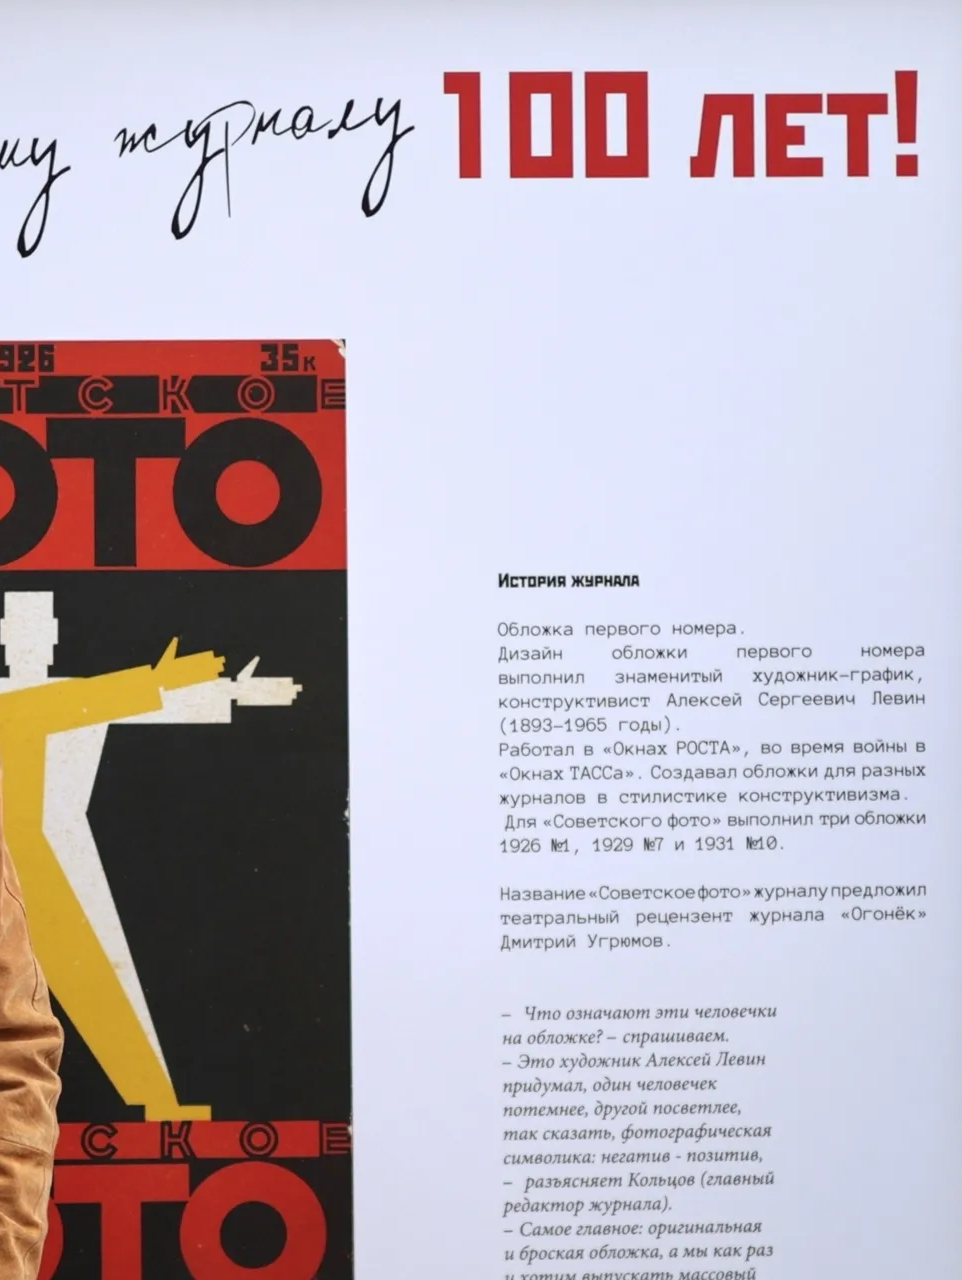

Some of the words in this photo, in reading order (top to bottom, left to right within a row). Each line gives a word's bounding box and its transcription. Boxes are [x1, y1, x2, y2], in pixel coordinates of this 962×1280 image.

[114, 97, 415, 240] журналу
[443, 71, 650, 179] 100
[496, 622, 574, 638] Обложка
[584, 624, 662, 640] первого
[671, 624, 745, 639] номера.
[497, 646, 563, 664] Дизайн
[611, 645, 688, 661] обложки
[736, 647, 813, 662] первого
[860, 645, 926, 661] номера
[497, 673, 585, 686] выполнил
[614, 669, 723, 685] знаменитый
[498, 696, 651, 713] конструктивист
[665, 693, 743, 708] Алексей
[757, 692, 856, 710] Сергеевич
[871, 690, 926, 706] Левин
[618, 715, 680, 735] годы).
[498, 742, 575, 758] Работал
[583, 745, 595, 757] в
[602, 741, 668, 757] «Окнах
[676, 740, 749, 759] РОСТА»,
[760, 743, 783, 755] во
[790, 742, 845, 758] время
[852, 739, 908, 754] войны
[915, 742, 927, 753] в
[499, 766, 565, 782] «Окнах
[569, 765, 642, 781] ТАССа».
[650, 764, 738, 783] Создавал
[742, 764, 819, 779] обложки
[823, 766, 856, 781] для
[861, 766, 927, 781] разных
[499, 793, 587, 809] журналов
[597, 793, 608, 805] в
[618, 792, 728, 805] стилистике
[738, 790, 908, 806] конструктивизма.
[503, 814, 537, 833] Для
[542, 814, 663, 829] «Советского
[666, 813, 722, 831] фото»
[727, 815, 814, 827] выполнил
[818, 814, 851, 830] три
[853, 810, 927, 826] обложки
[499, 838, 542, 854] 1926
[591, 837, 634, 853] 1929
[642, 837, 665, 852] №7
[674, 840, 685, 852] и
[694, 836, 735, 852] 1931
[499, 886, 587, 902] Название
[753, 886, 829, 903] журналу
[830, 885, 927, 901] предложил
[499, 910, 620, 929] театральный
[635, 912, 734, 928] рецензент
[749, 910, 825, 927] журнала
[840, 906, 927, 922] «Огонёк»
[499, 934, 577, 953] Дмитрий
[587, 934, 671, 952] Угрюмов.
[524, 1006, 562, 1021] Что
[565, 1008, 651, 1021] означают
[654, 1008, 690, 1020] эти
[693, 1007, 778, 1019] человечки
[502, 1034, 523, 1046] на
[526, 1029, 604, 1045] обложке?
[622, 1032, 729, 1050] спрашиваем.
[517, 1054, 556, 1070] Это
[558, 1052, 642, 1074] художник
[644, 1052, 712, 1068] Алексей
[714, 1051, 766, 1067] Левин
[502, 1077, 588, 1099] придумал,
[592, 1076, 632, 1093] один
[636, 1080, 718, 1092] человечек
[502, 1105, 589, 1119] потемнее,
[593, 1100, 648, 1121] другой
[652, 1103, 742, 1116] посветлее,
[503, 1130, 539, 1141] так
[542, 1129, 616, 1142] сказать,
[620, 1123, 773, 1145] фотографическая
[502, 1153, 597, 1166] символика:
[601, 1152, 671, 1165] негатив
[686, 1151, 764, 1164] позитив,
[523, 1177, 623, 1194] разъясняет
[627, 1172, 696, 1190] Кольцов
[700, 1171, 775, 1189] (главный
[501, 1197, 585, 1219] редактор
[587, 1196, 673, 1217] журнала).
[519, 1222, 573, 1238] Самое
[575, 1224, 644, 1237] главное:
[647, 1222, 763, 1240] оригинальная
[504, 1250, 515, 1262] и
[518, 1245, 585, 1266] броская
[588, 1244, 664, 1261] обложка,
[668, 1248, 679, 1259] а
[681, 1248, 709, 1259] мы
[713, 1247, 743, 1258] как
[744, 1245, 774, 1263] раз
